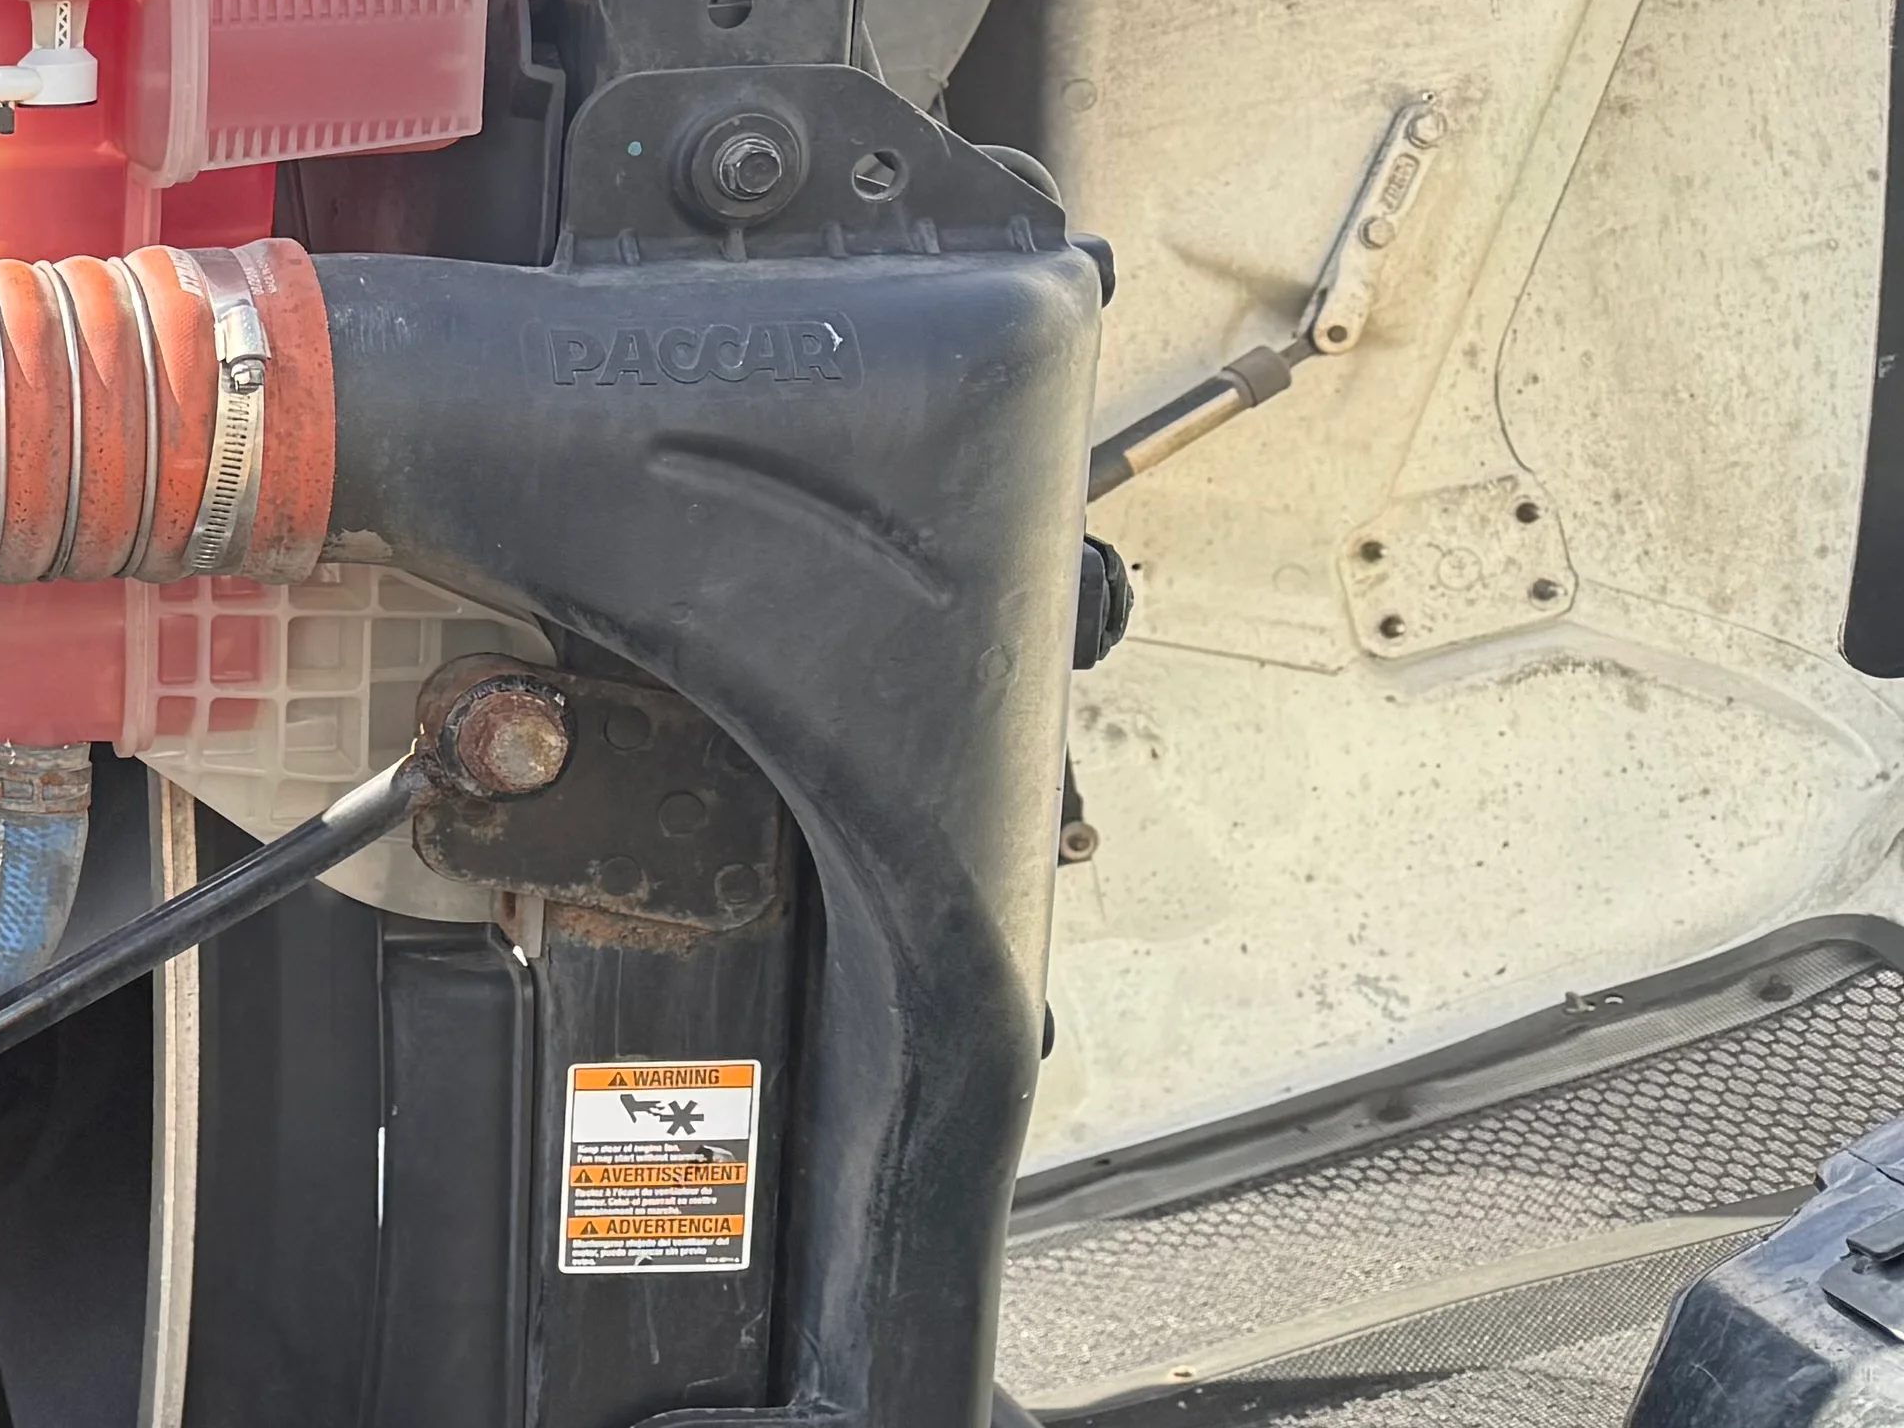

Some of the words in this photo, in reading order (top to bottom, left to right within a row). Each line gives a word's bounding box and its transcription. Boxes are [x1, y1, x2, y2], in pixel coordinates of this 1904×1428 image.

[545, 321, 845, 388] PACCAR
[633, 1069, 721, 1087] WARNING
[600, 1165, 745, 1183] AVERTISSEMENT
[606, 1218, 732, 1234] ADVERTENCIA
